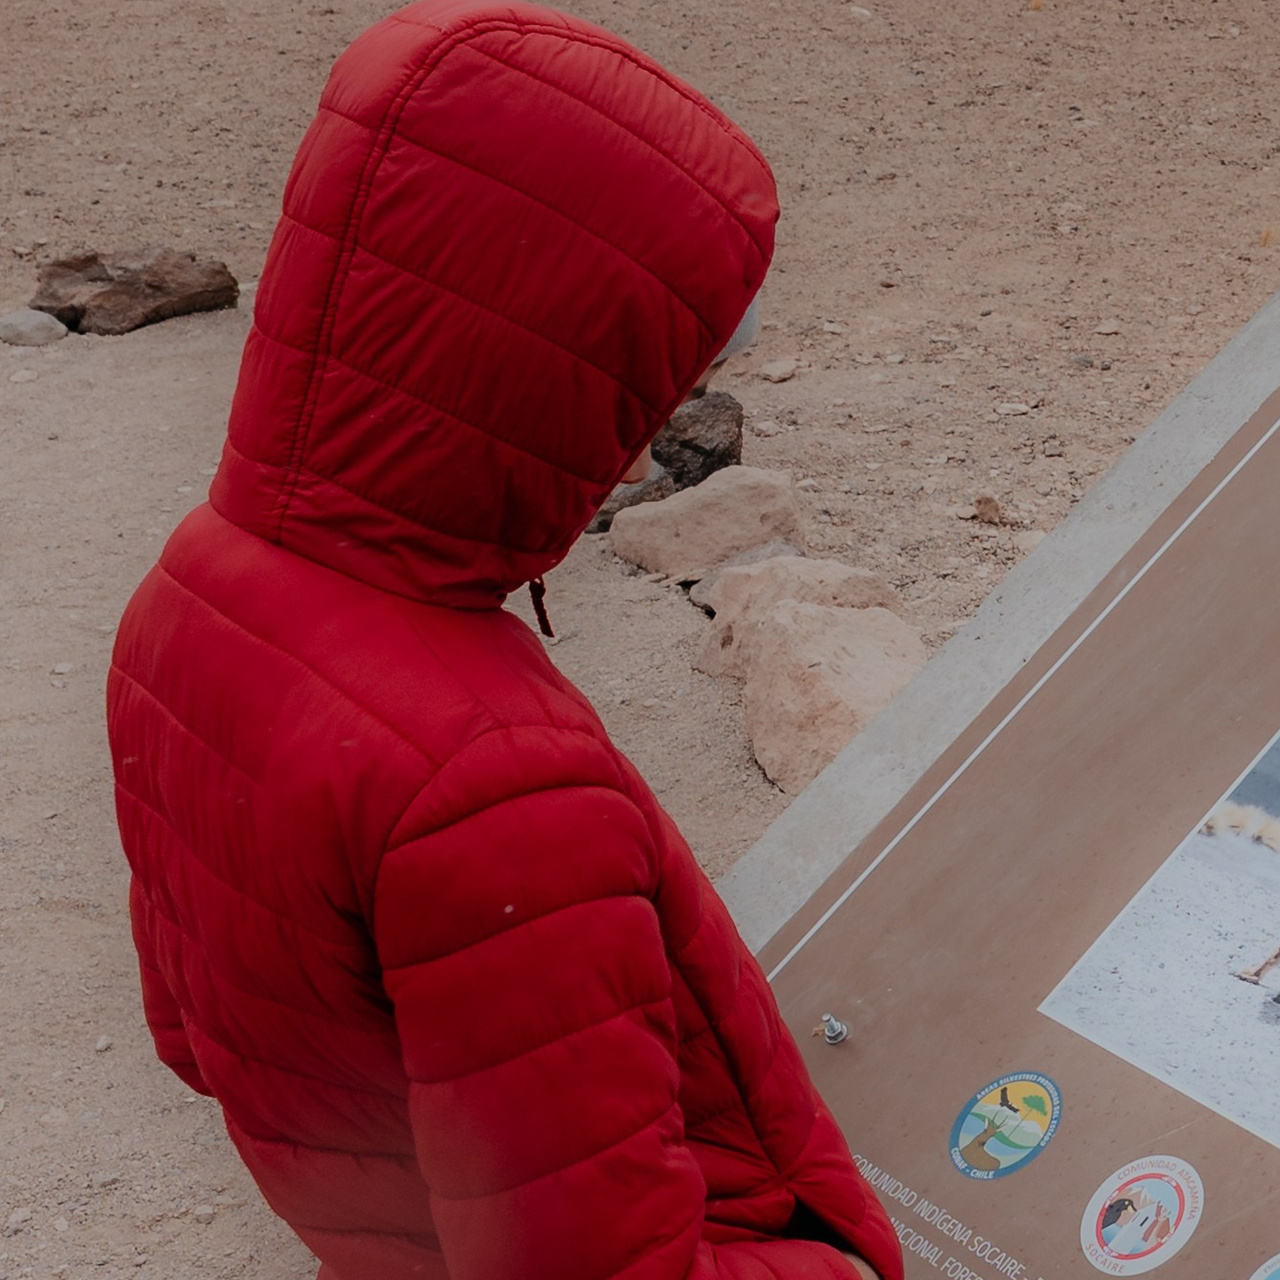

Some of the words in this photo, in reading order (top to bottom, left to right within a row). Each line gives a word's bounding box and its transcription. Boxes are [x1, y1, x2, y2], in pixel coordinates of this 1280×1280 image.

[970, 1169, 995, 1179] CHILE
[1117, 1160, 1177, 1181] COMUNIDAD
[913, 1197, 973, 1246] INDÍGENA
[968, 1236, 1026, 1280] SOCAIRE
[1085, 1243, 1126, 1273] SOCAIRE
